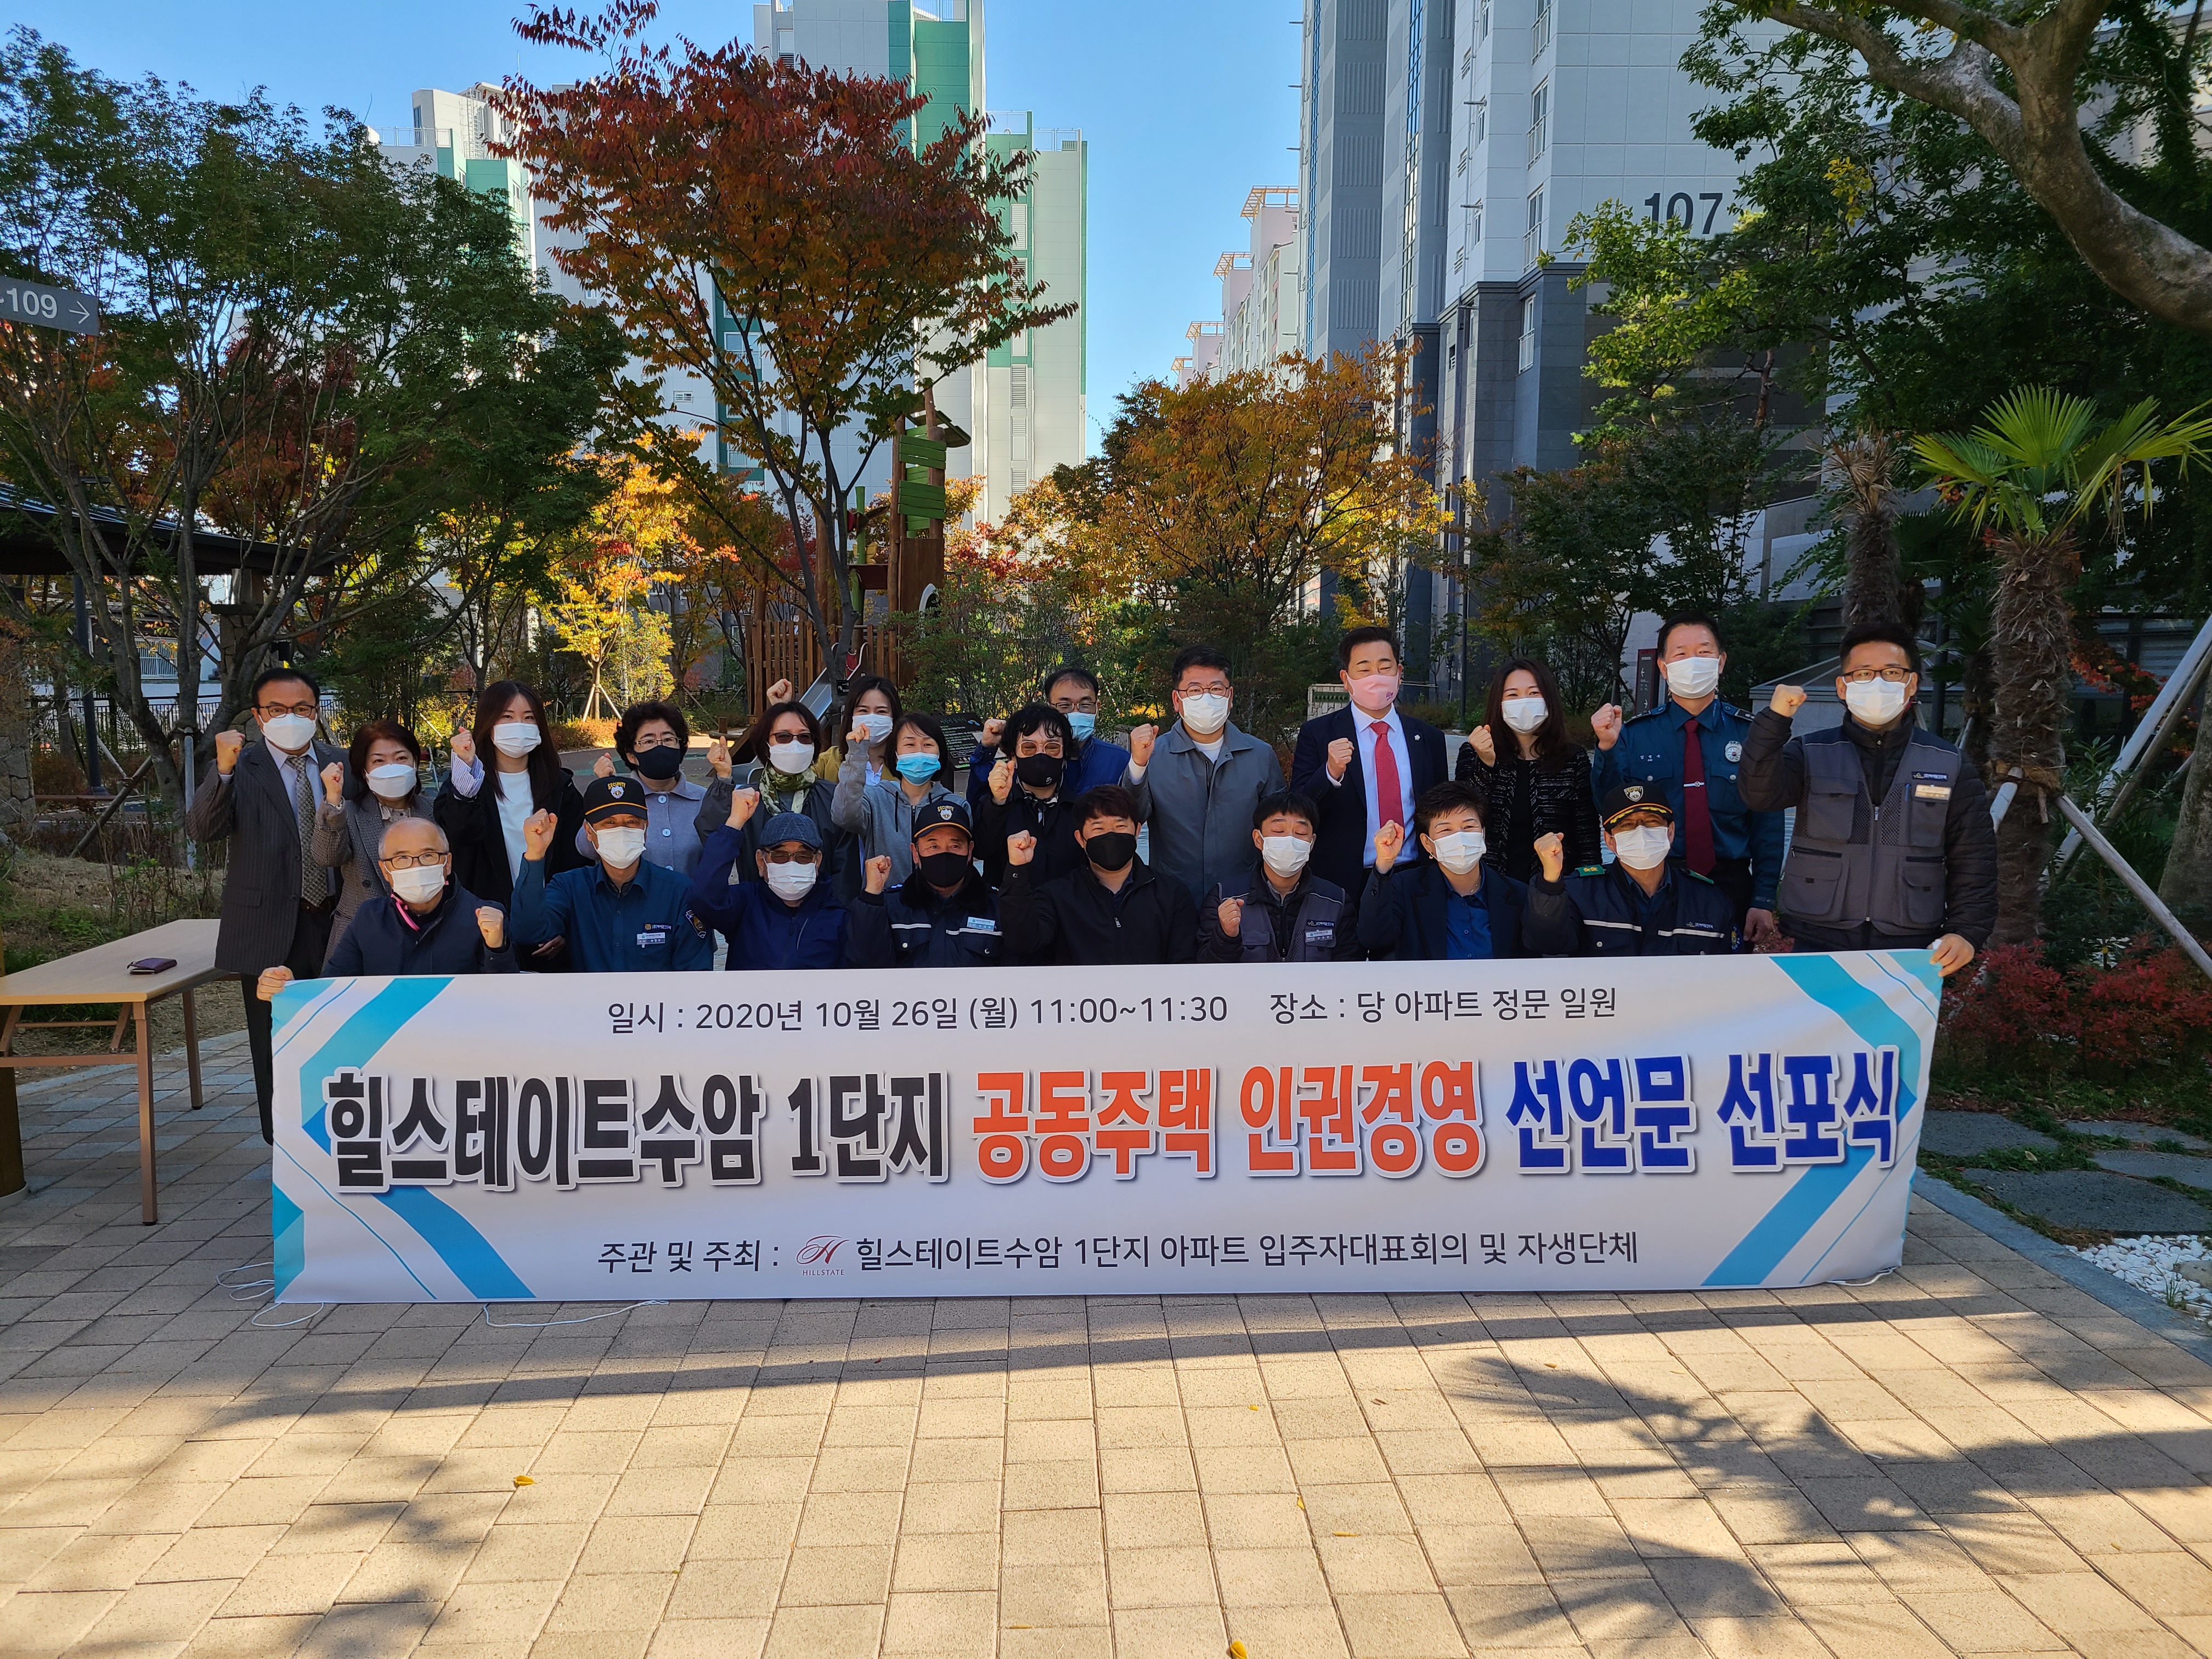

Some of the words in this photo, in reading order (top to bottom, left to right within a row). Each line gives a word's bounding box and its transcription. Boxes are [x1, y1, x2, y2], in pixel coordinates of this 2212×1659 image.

[1644, 192, 1723, 235] 107
[607, 782, 626, 790] SECURITY
[608, 1002, 664, 1034] 일시
[678, 1009, 683, 1028] :
[696, 1000, 802, 1031] 2020년
[816, 999, 880, 1030] 10월
[892, 998, 957, 1029] 26일
[970, 997, 1018, 1029] (월)
[1031, 996, 1228, 1024] 11:00~11:30
[1270, 992, 1328, 1024] 장소
[1340, 998, 1345, 1018] :
[1358, 991, 1386, 1023] 당
[1395, 990, 1483, 1022] 아파트
[1493, 989, 1550, 1020] 정문
[1560, 988, 1616, 1019] 일원
[328, 1073, 760, 1187] 힐스테이트수암
[787, 1073, 951, 1182] 1단지
[973, 1068, 1211, 1177] 공동주택
[1240, 1061, 1479, 1172] 인권경영
[1506, 1056, 1690, 1167] 선언문
[1717, 1051, 1895, 1166] 선포식
[598, 1241, 657, 1273] 주관
[668, 1240, 693, 1273] 및
[703, 1240, 760, 1272] 주최
[773, 1246, 778, 1266] :
[856, 1236, 1063, 1271] 힐스테이트수암
[1075, 1235, 1149, 1268] 1단지
[1161, 1235, 1250, 1267] 아파트
[1260, 1233, 1468, 1266] 입주자대표회의
[1480, 1233, 1507, 1265] 및
[1517, 1232, 1638, 1265] 자생단체
